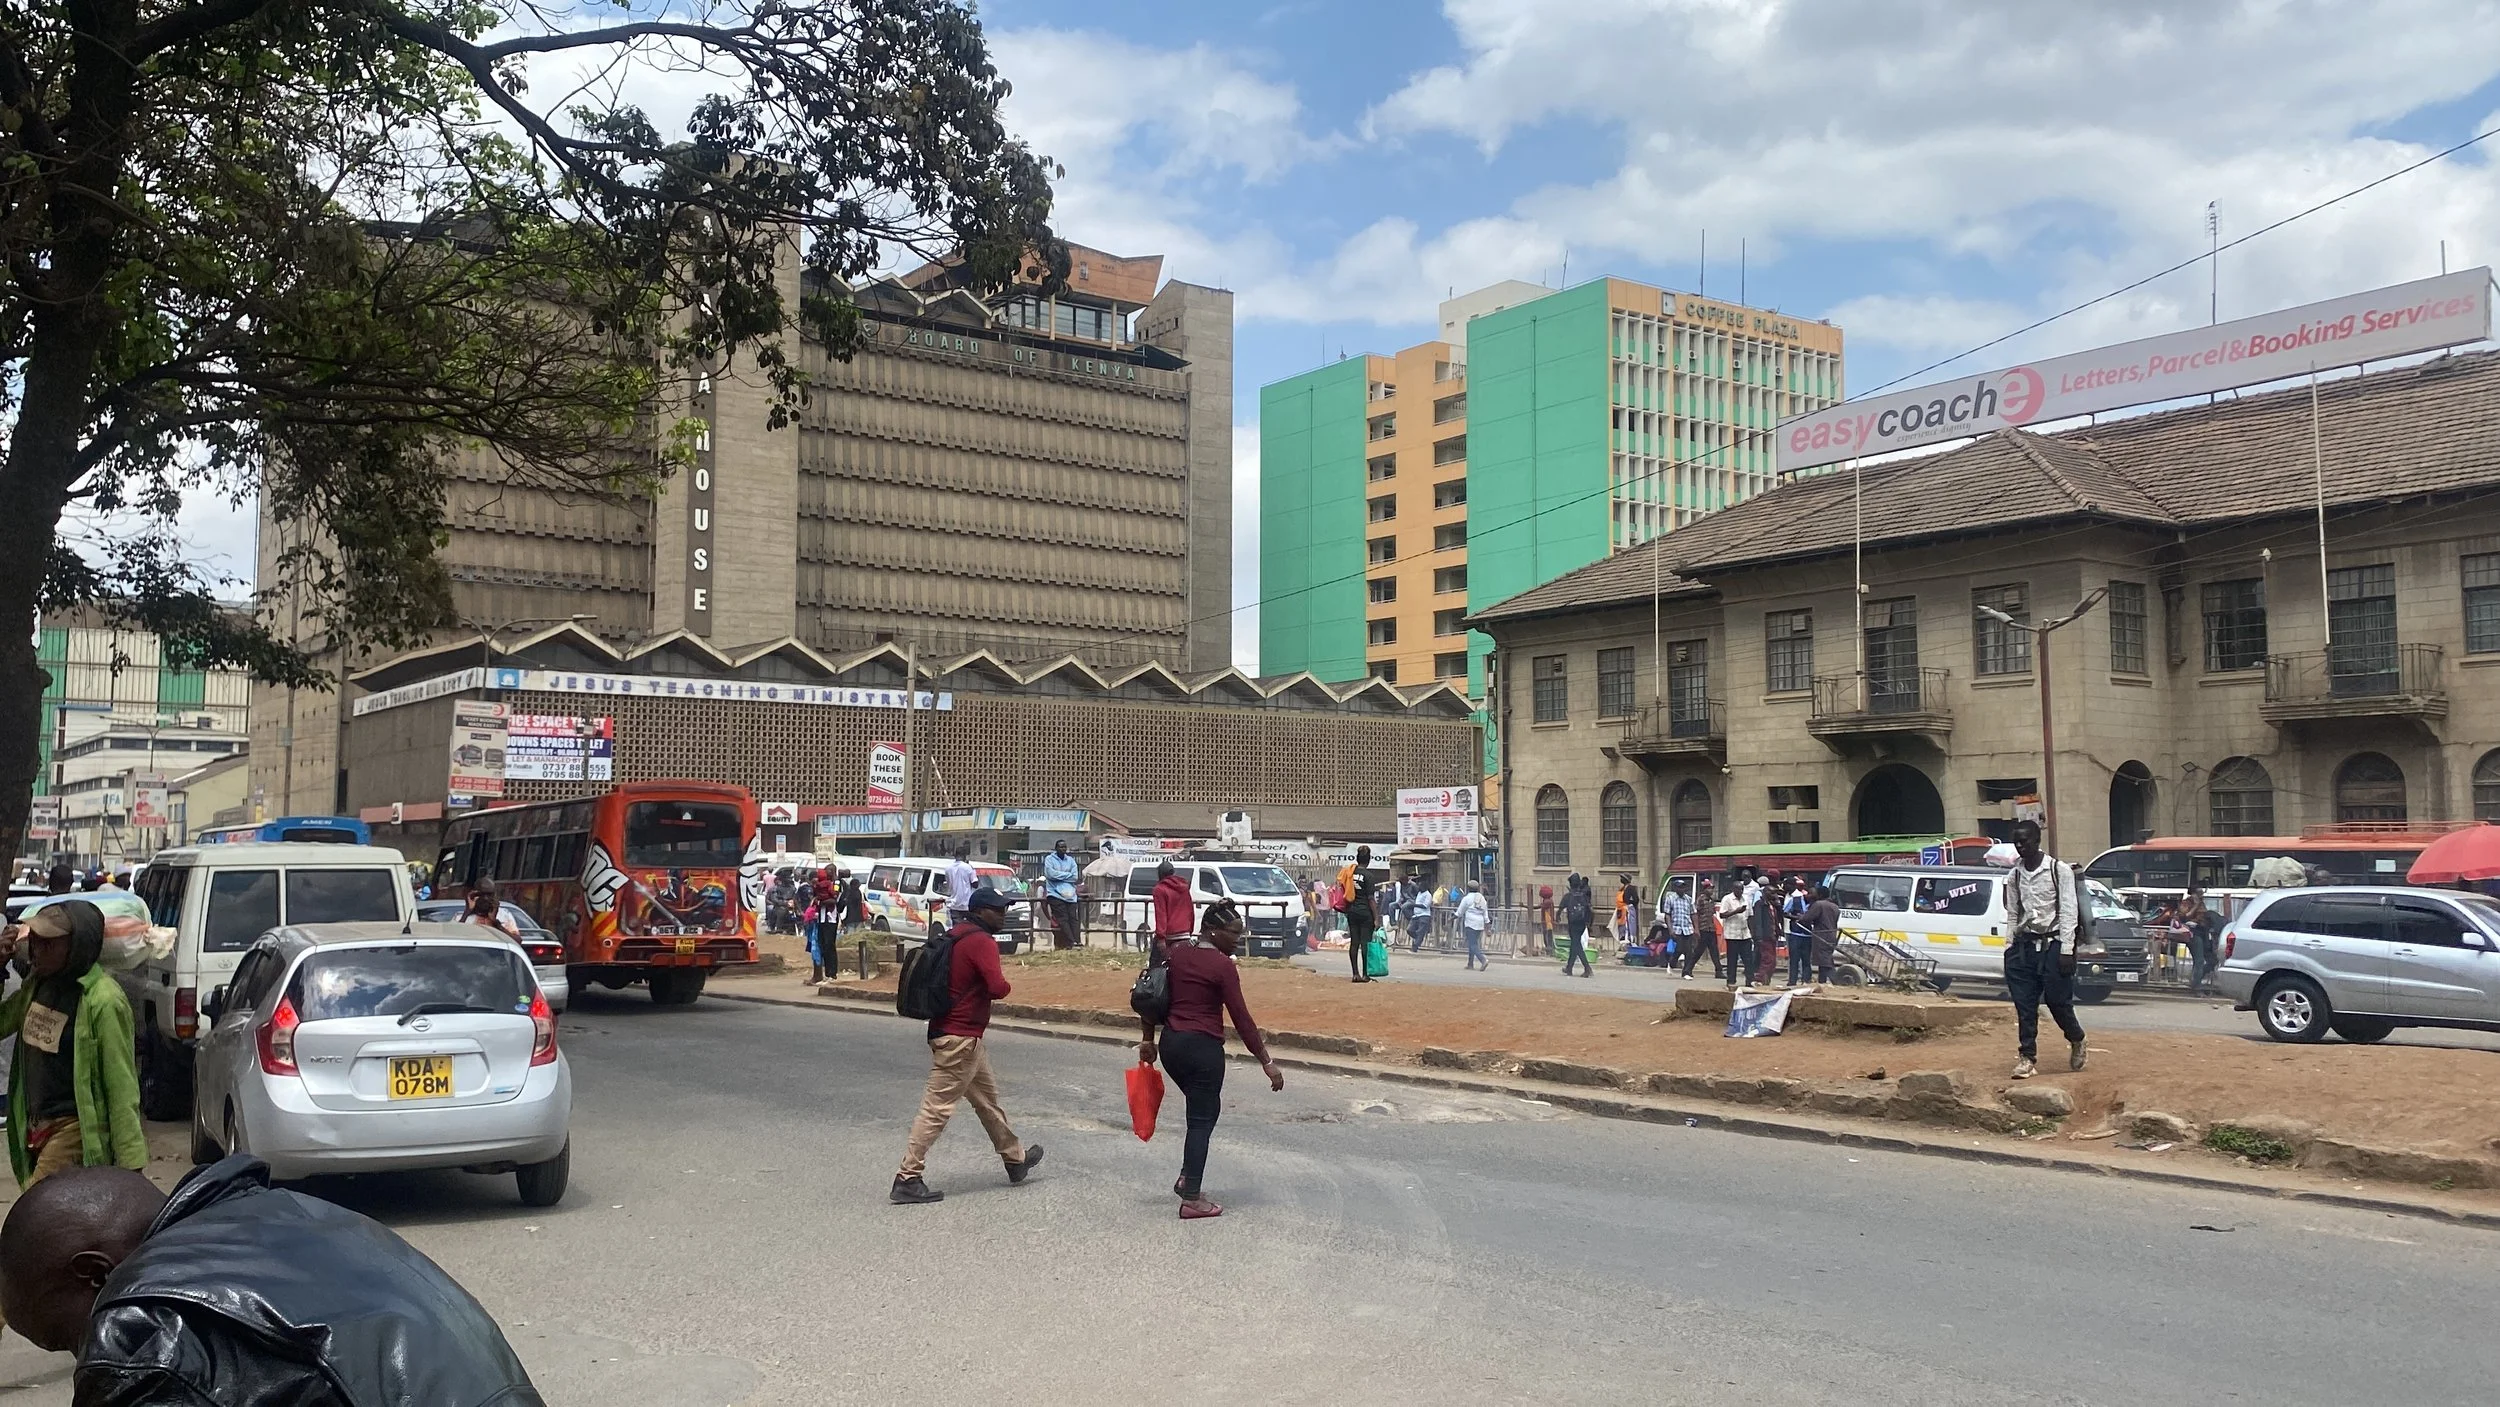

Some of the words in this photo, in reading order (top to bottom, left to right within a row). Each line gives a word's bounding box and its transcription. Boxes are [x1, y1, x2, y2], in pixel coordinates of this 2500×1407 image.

[2360, 293, 2476, 335] Services
[1686, 302, 1744, 328] COFFEE
[1754, 317, 1798, 340] PLAZA
[908, 329, 979, 354] BOARD
[1014, 349, 1037, 366] OF
[1072, 357, 1136, 381] KENYA
[1790, 380, 1998, 454] easycoach
[694, 429, 710, 611] HOUSE
[550, 676, 632, 693] JESUS
[650, 680, 779, 700] TEACHING
[793, 688, 909, 707] MINISTRY
[532, 715, 569, 728] SPACE
[540, 737, 576, 748] SPACES
[589, 739, 605, 750] LET
[876, 754, 901, 762] BOOK
[542, 763, 566, 771] 0737
[589, 764, 606, 772] 555
[873, 765, 902, 773] THESE
[542, 771, 566, 779] 0795
[870, 776, 904, 784] SPACES
[1404, 795, 1440, 806] easycoach
[1019, 811, 1050, 821] ELDORET
[310, 1055, 343, 1064] NOTE
[394, 1058, 434, 1078] KDA
[395, 1076, 449, 1096] 078M
